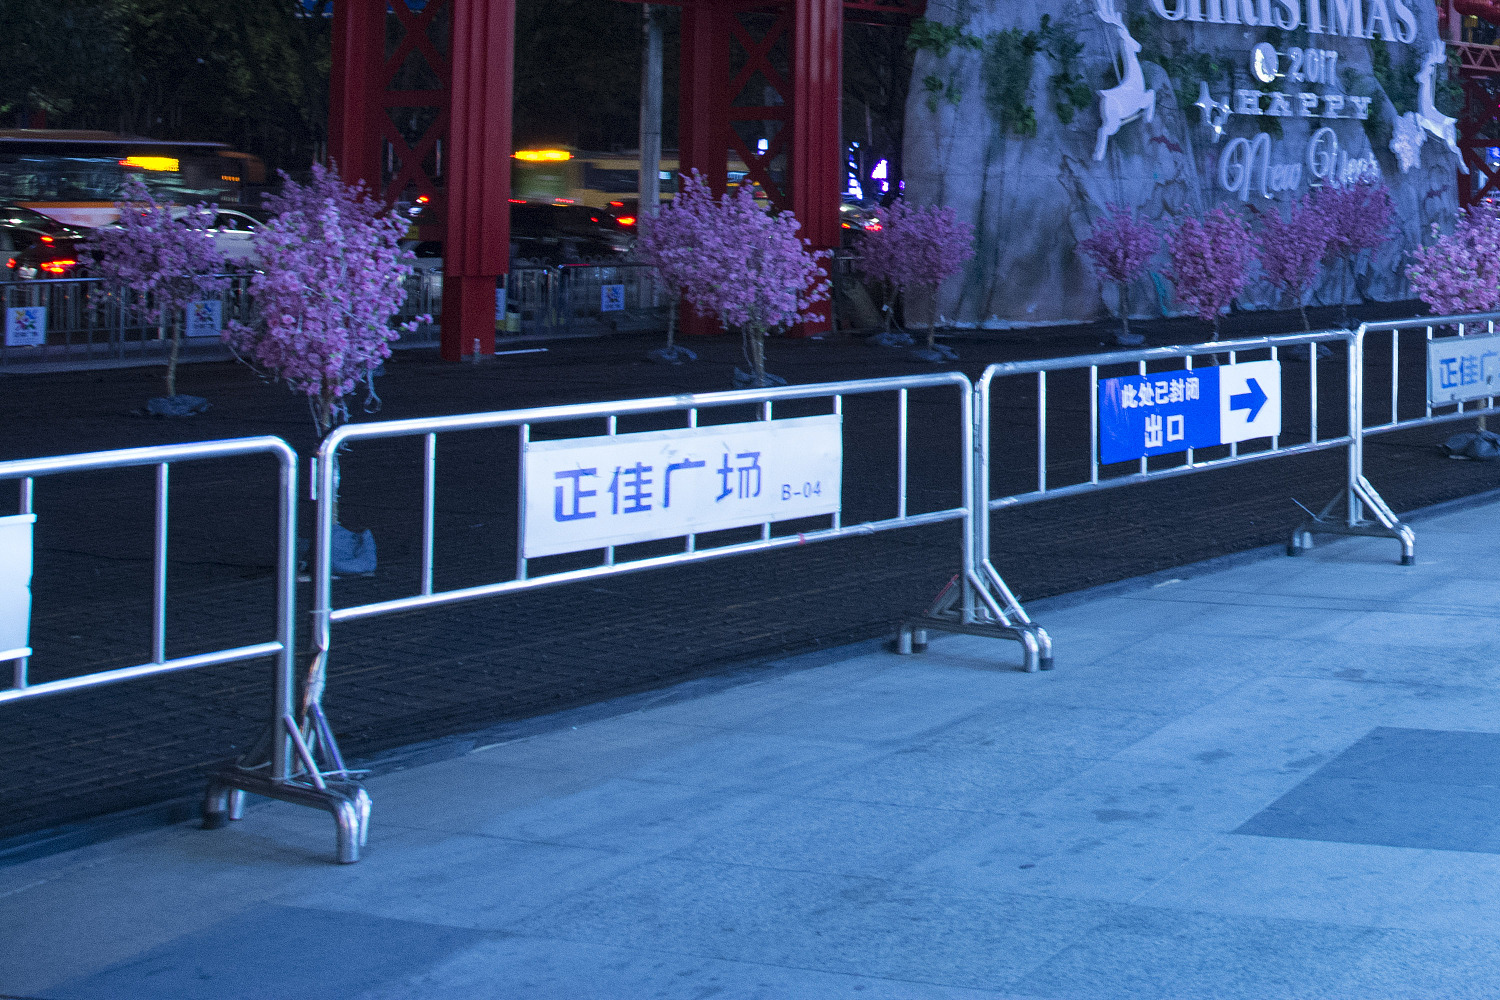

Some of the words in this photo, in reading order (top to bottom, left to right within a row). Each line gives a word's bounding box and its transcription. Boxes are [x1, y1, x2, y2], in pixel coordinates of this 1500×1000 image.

[1287, 46, 1338, 85] 2017
[1234, 88, 1373, 120] HAPPY
[1218, 132, 1303, 201] New
[1121, 376, 1200, 409] 此处已封闭
[1144, 413, 1185, 448] 出口
[554, 451, 762, 522] 正佳广场
[781, 481, 822, 501] B-04
